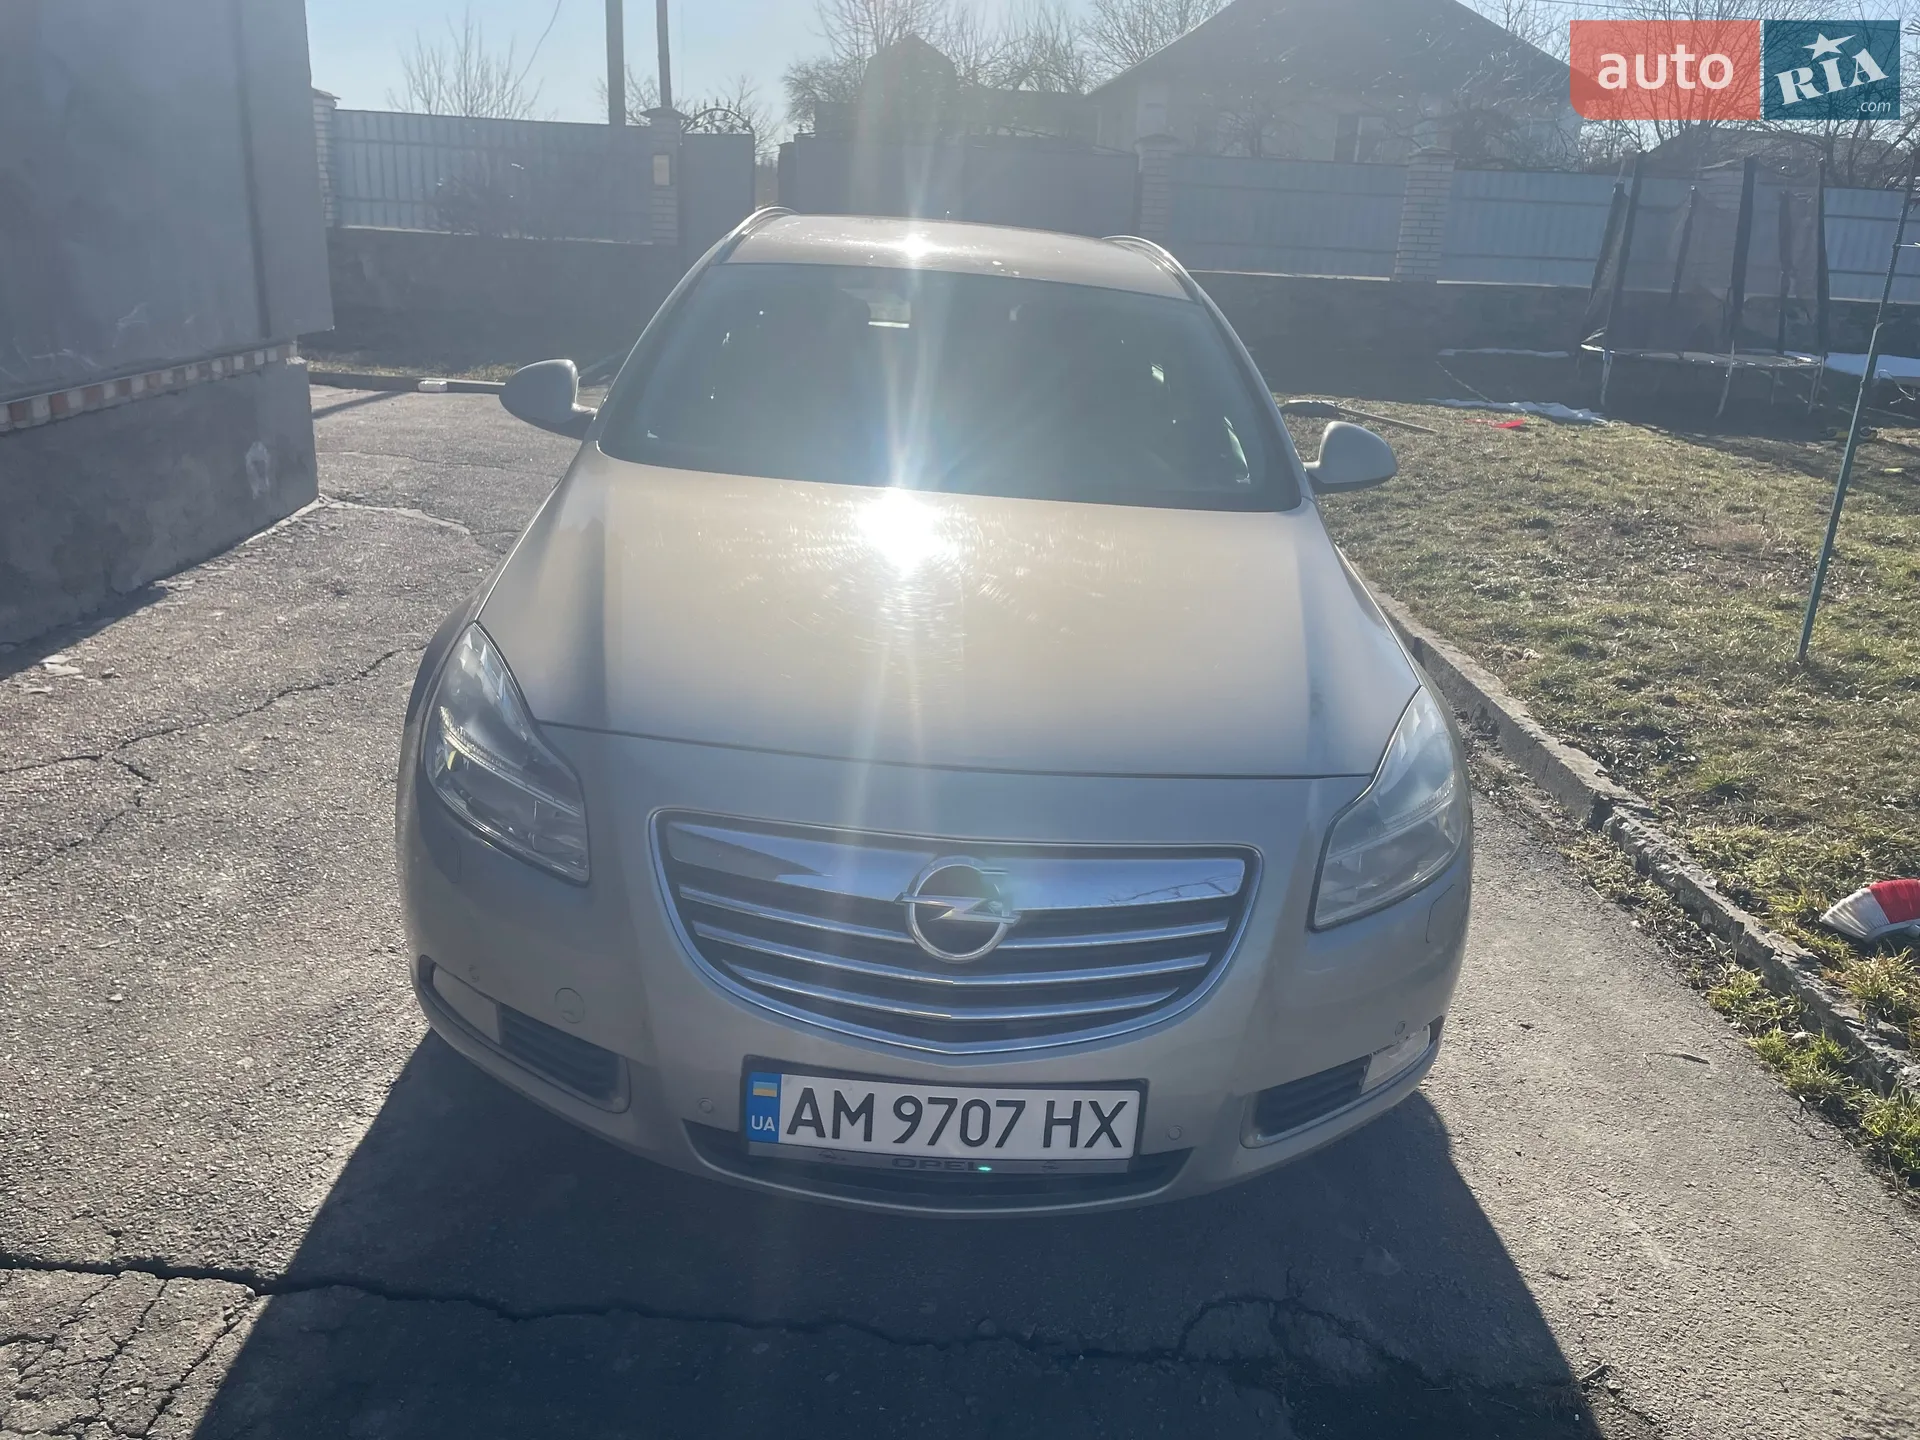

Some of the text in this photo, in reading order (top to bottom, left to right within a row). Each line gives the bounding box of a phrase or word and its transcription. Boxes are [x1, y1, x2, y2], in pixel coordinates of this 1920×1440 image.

[751, 1115, 776, 1132] UA
[786, 1087, 1128, 1149] AM 9707 HX
[892, 1157, 981, 1172] OPEL
